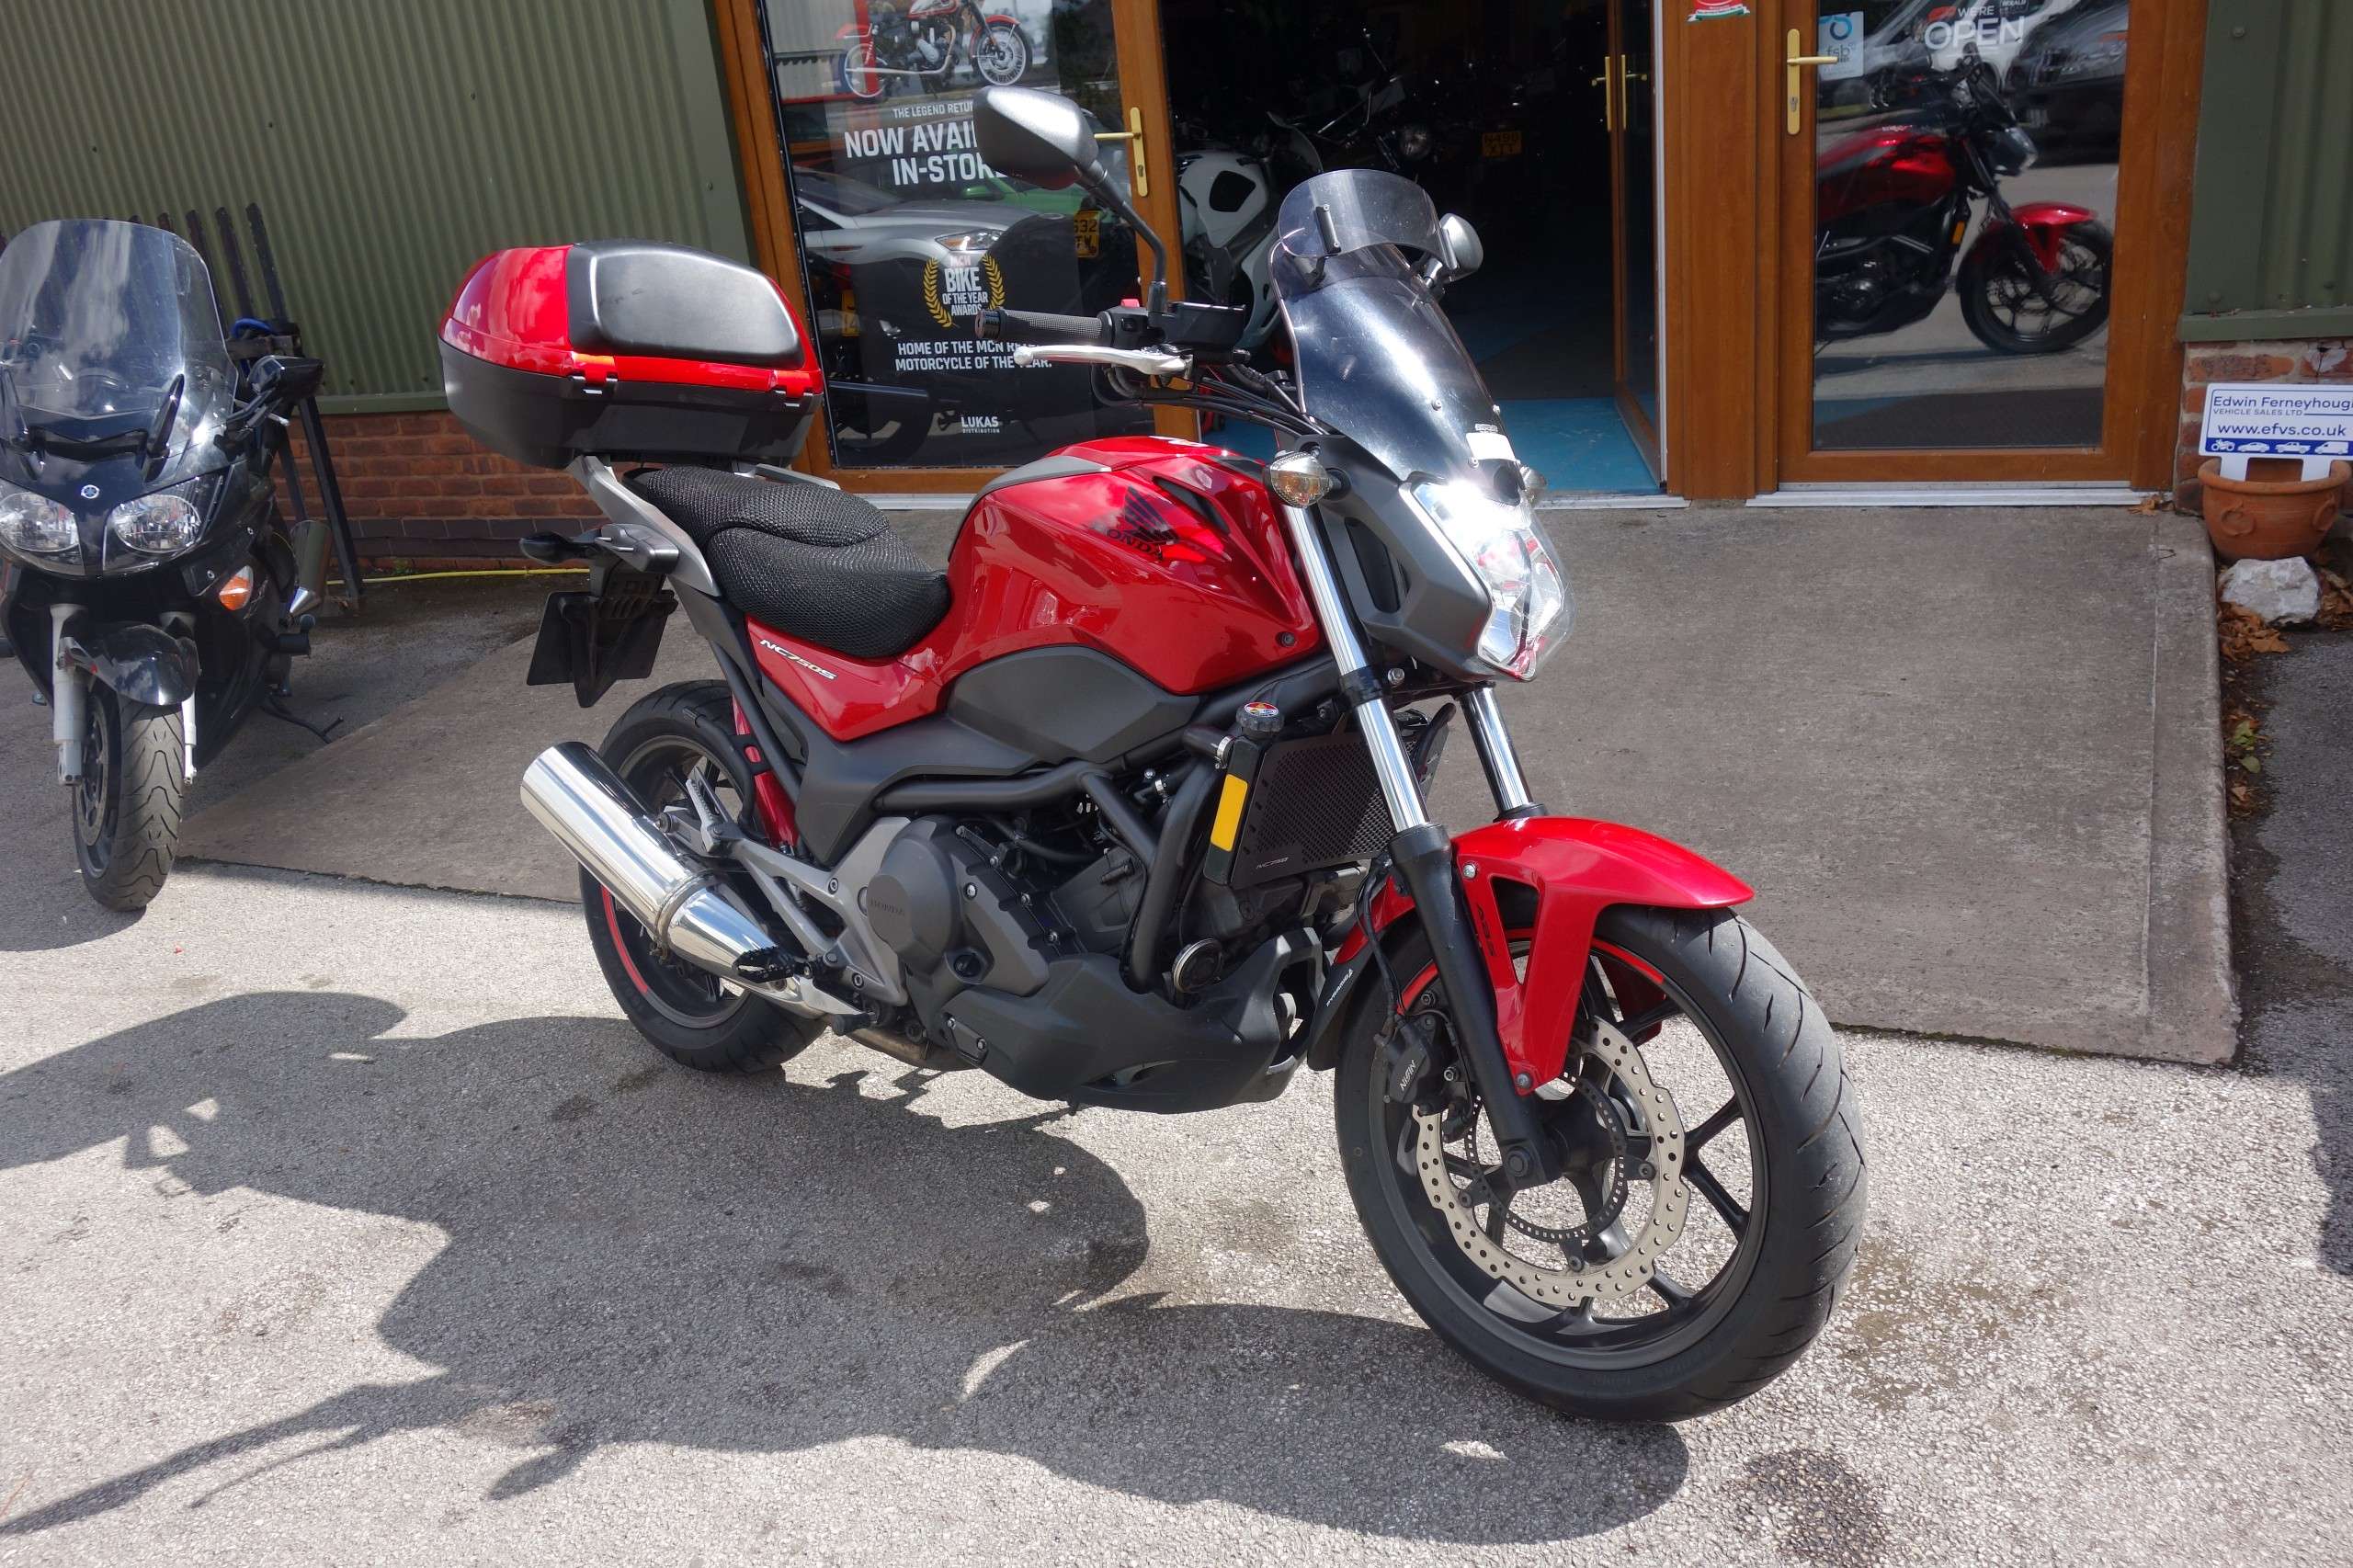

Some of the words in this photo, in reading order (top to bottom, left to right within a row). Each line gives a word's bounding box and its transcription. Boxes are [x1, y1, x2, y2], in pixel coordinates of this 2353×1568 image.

[1925, 16, 2025, 50] OPEN
[893, 108, 911, 119] THE
[912, 104, 946, 118] LEGEND
[844, 127, 904, 159] NOW
[944, 266, 982, 292] BIKE
[942, 293, 952, 305] OF
[952, 292, 968, 304] THE
[968, 291, 989, 303] YEAR
[897, 342, 932, 356] HOME
[934, 341, 949, 355] OF
[953, 341, 973, 354] THE
[976, 340, 1005, 353] MCN
[895, 358, 972, 371] MOTORCYCLE
[974, 357, 990, 369] OF
[993, 356, 1015, 369] THE
[2213, 396, 2257, 407] Edwin
[961, 416, 999, 428] LUKAS
[2218, 423, 2347, 437] www.efvs.co.uk
[760, 639, 837, 680] NC750S
